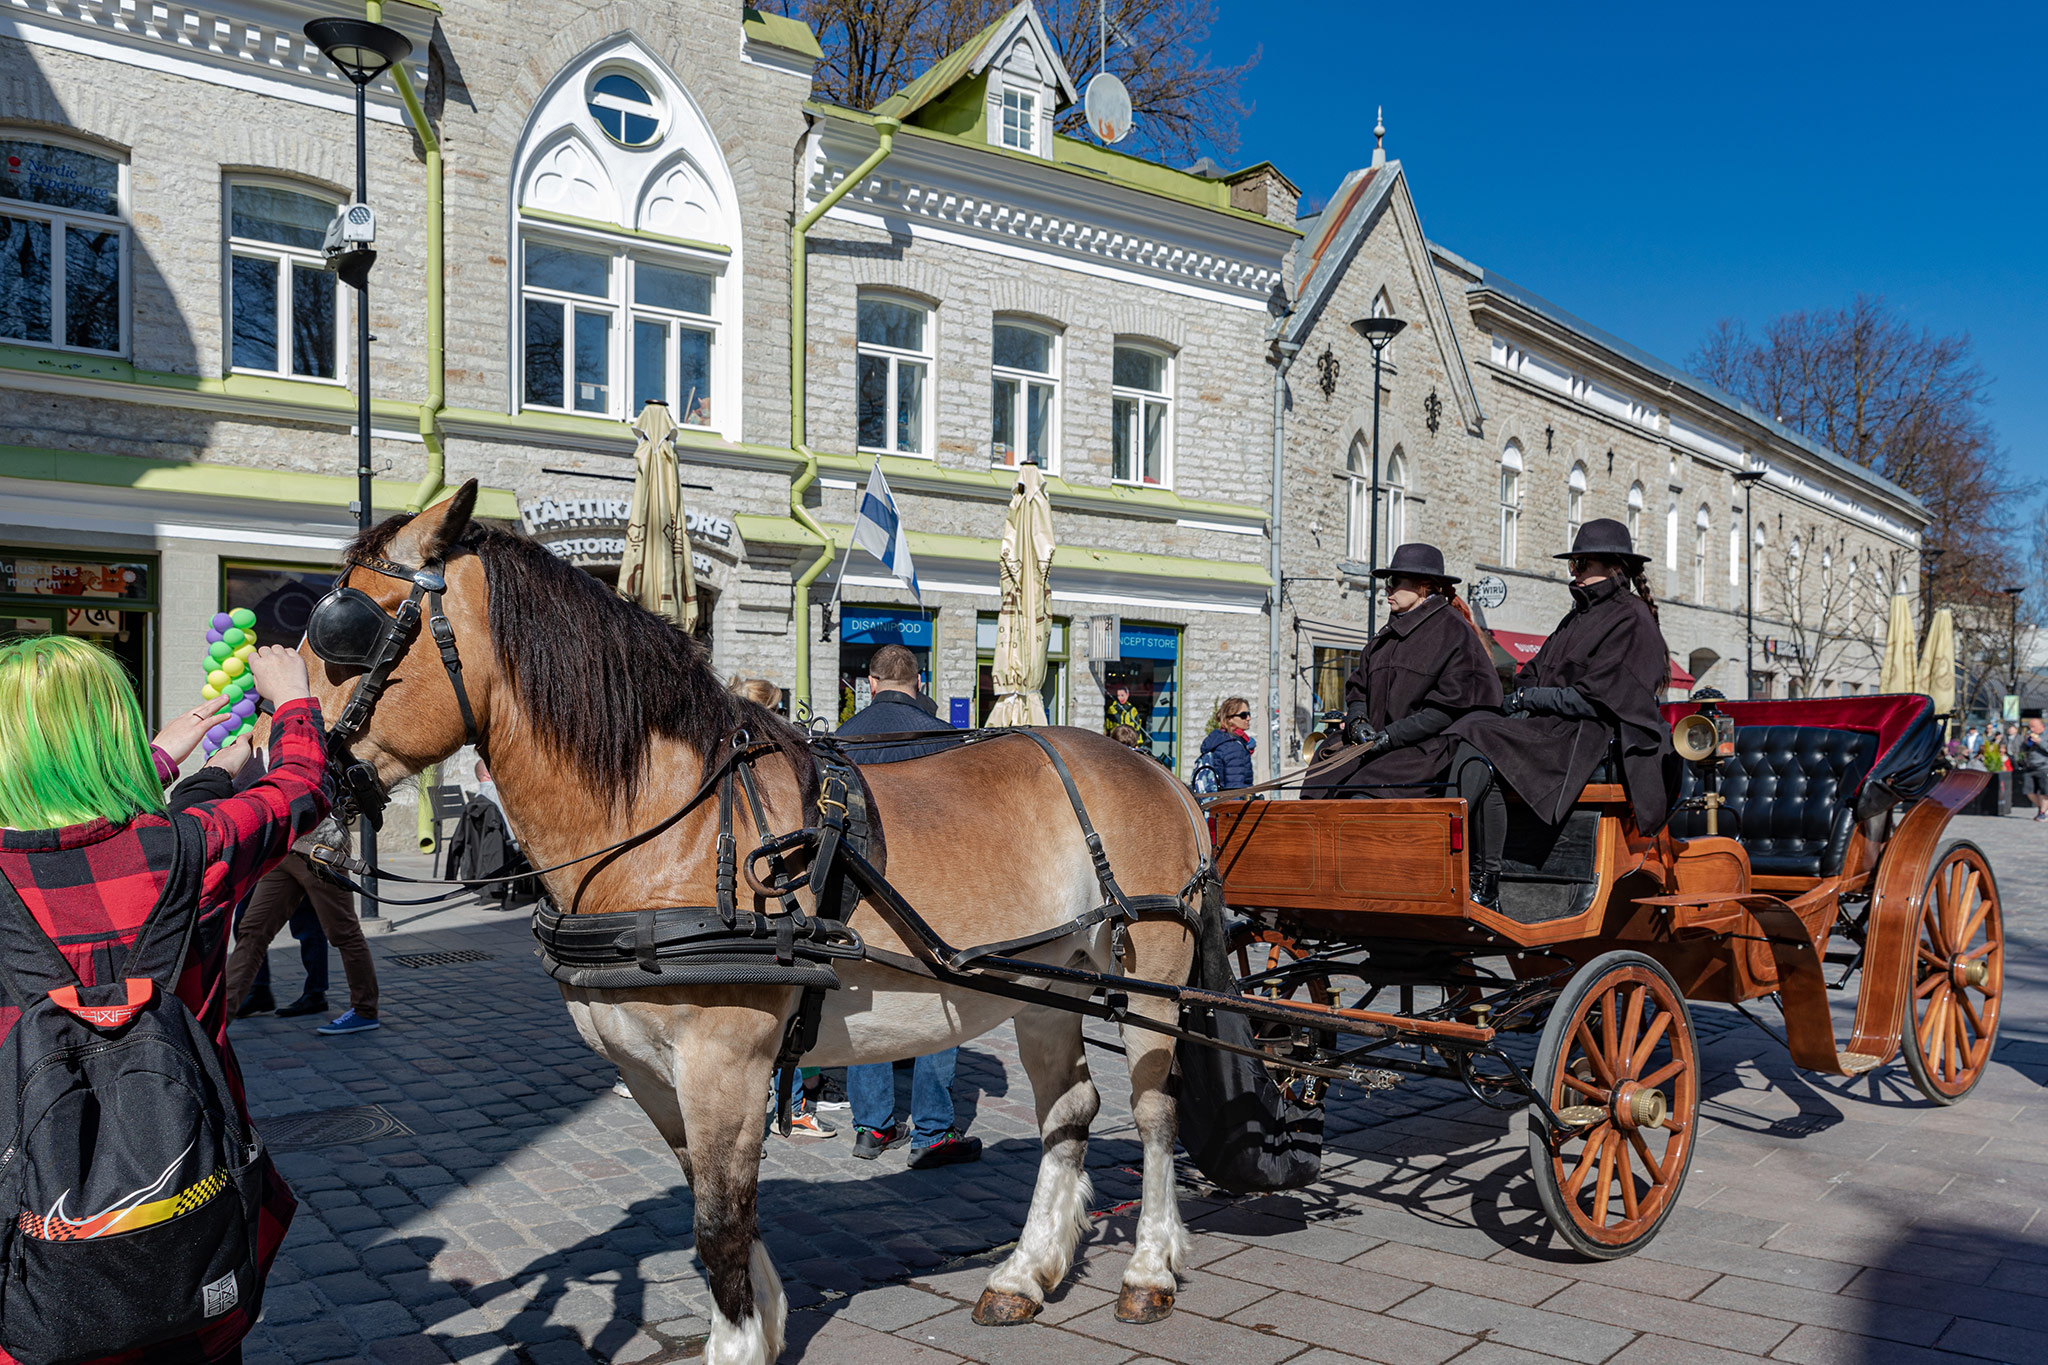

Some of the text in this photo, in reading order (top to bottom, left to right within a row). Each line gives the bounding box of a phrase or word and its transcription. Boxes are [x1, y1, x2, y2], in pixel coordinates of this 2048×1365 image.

[27, 159, 78, 179] Nordic
[27, 173, 109, 198] Experience
[851, 619, 922, 634] DISAINIPOOD
[1147, 638, 1176, 649] STORE
